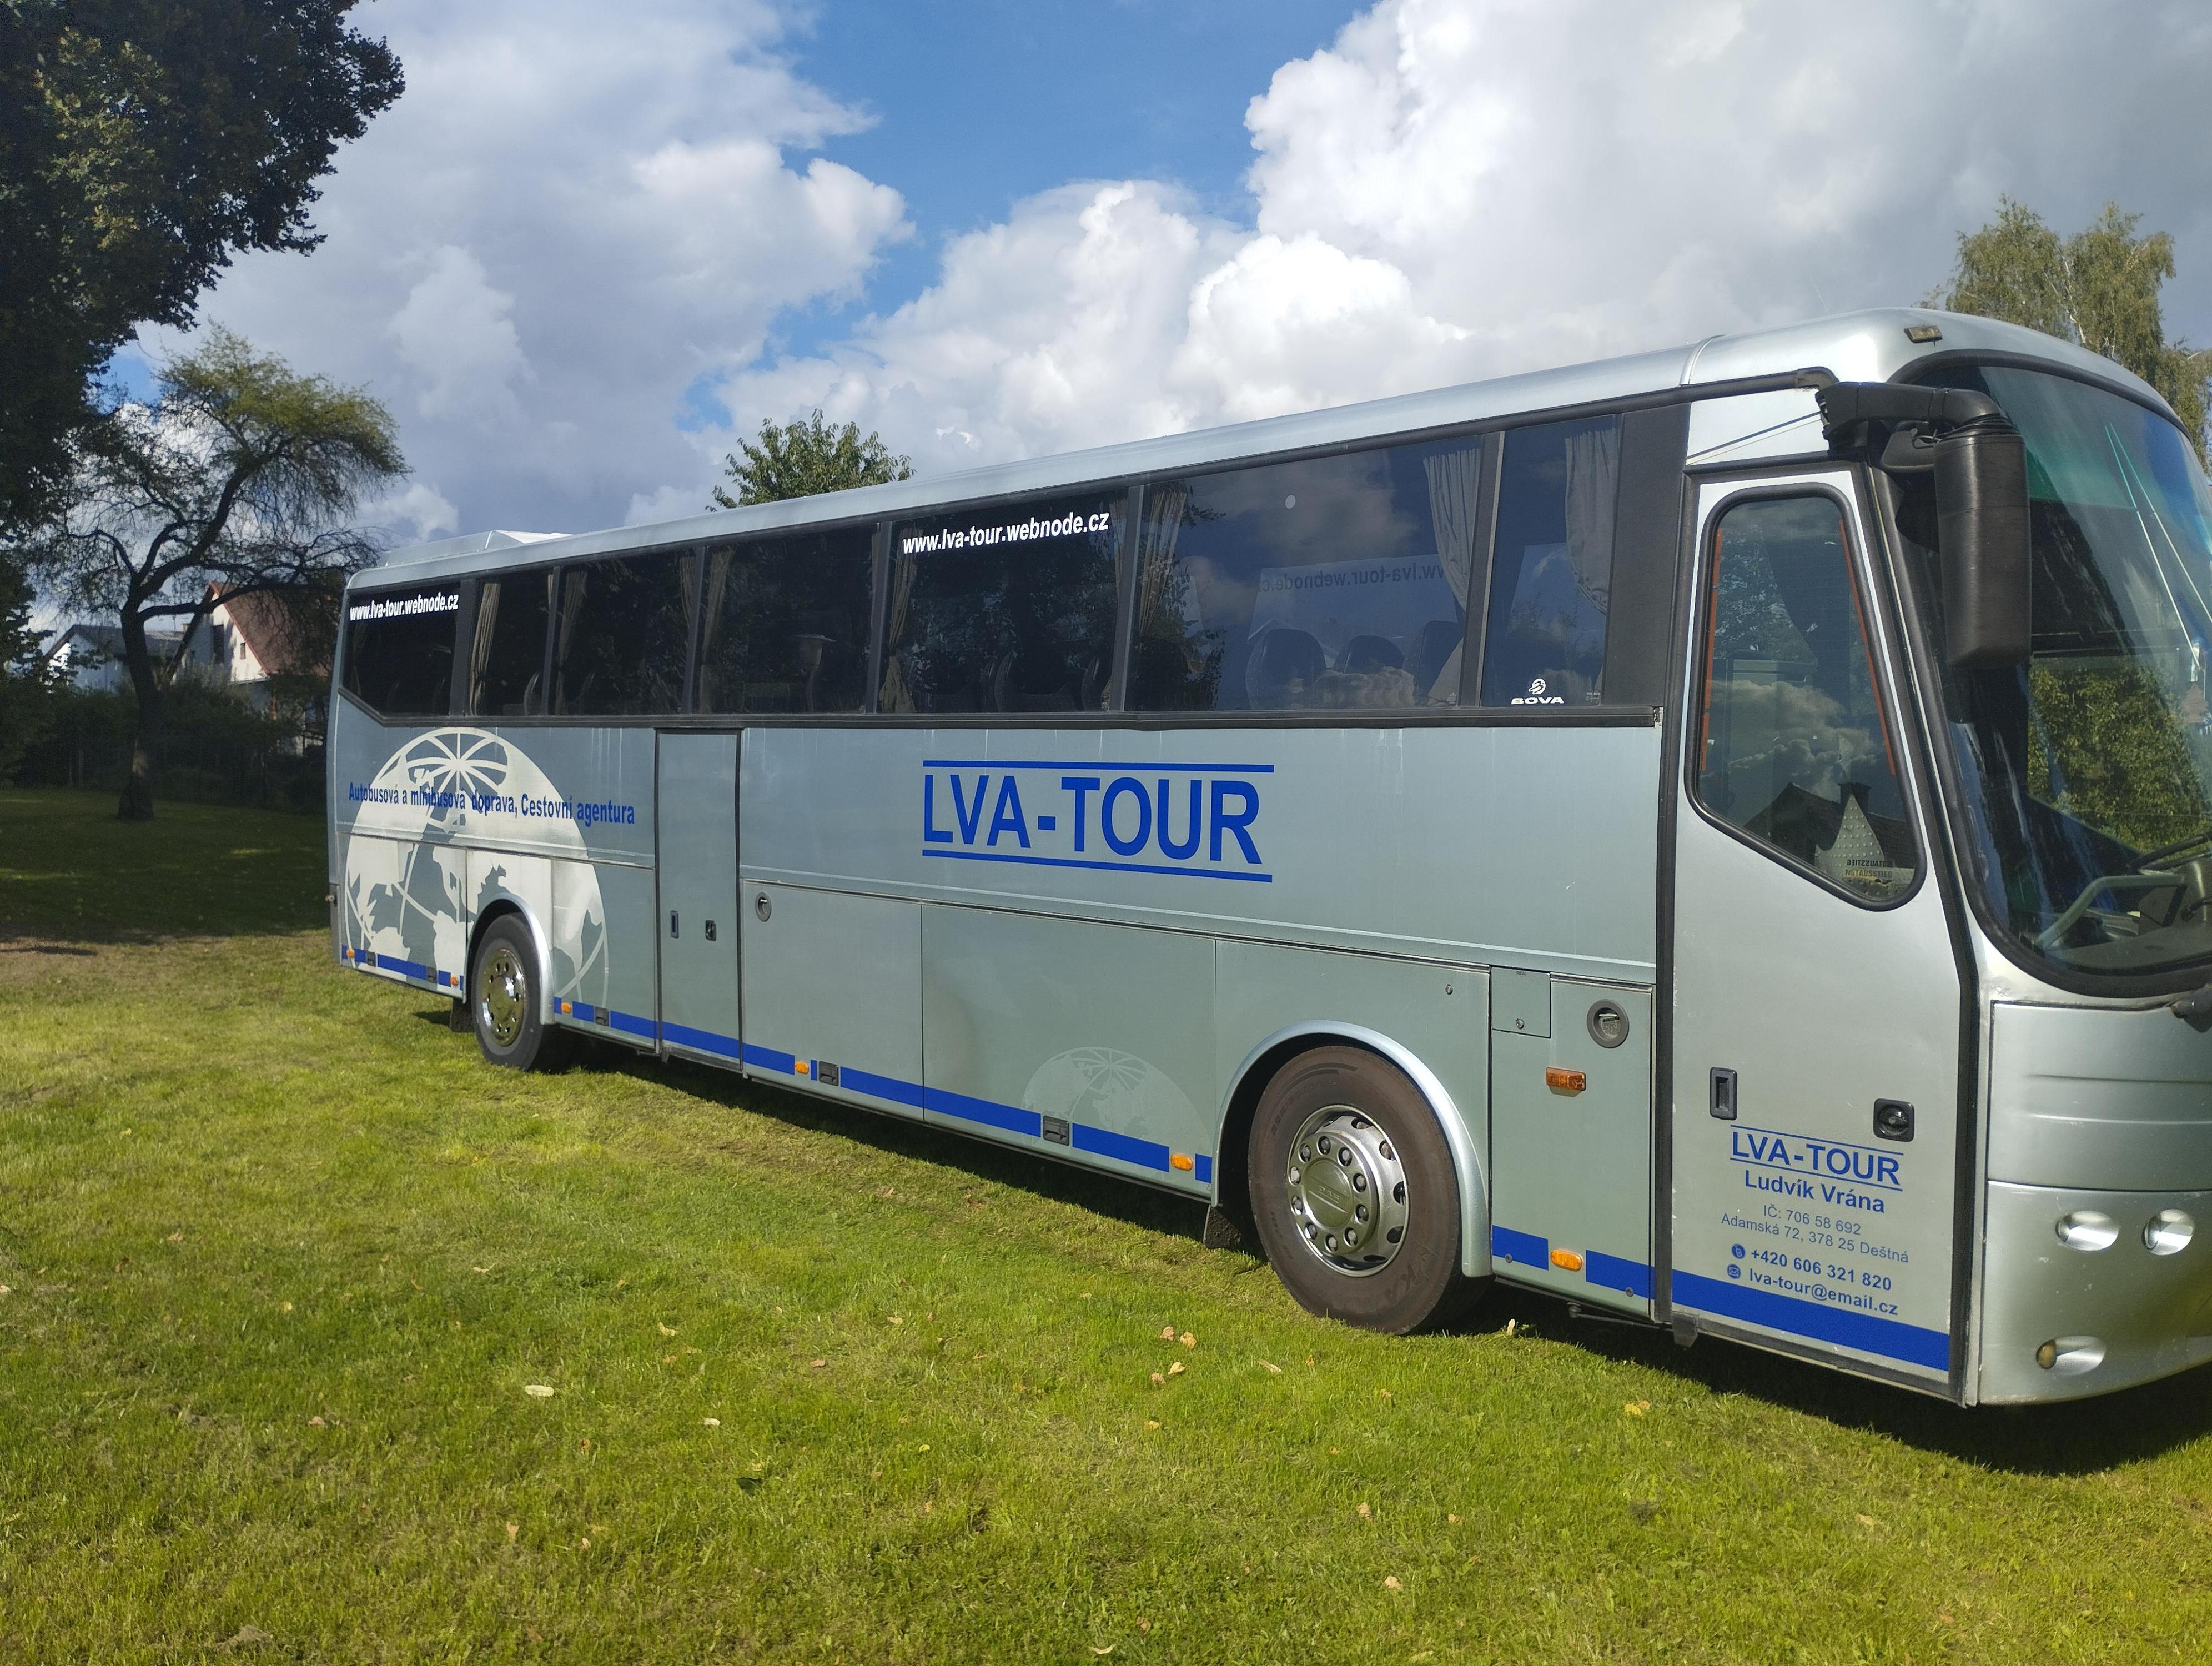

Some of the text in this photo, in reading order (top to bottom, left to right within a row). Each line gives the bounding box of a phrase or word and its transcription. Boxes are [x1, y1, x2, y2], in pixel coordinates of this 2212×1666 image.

[903, 511, 1109, 554] www.lva-tour.webnode.cz
[350, 593, 459, 621] www.lva-tour.webnode.cz
[349, 782, 635, 827] Autobusová a minibusová doprava, Cestovní agentura
[924, 774, 1263, 865] LVA-TOUR
[1732, 1131, 1901, 1186] LVA-TOUR
[1745, 1170, 1885, 1213] Ludvík Vrána
[1721, 1213, 1909, 1263] Adamská 72, 378 25 Deštná
[1764, 1204, 1861, 1236] IČ: 706 58 692
[1750, 1268, 1898, 1316] lva-tour@email.cz
[1751, 1249, 1892, 1291] +420 606 321 820
